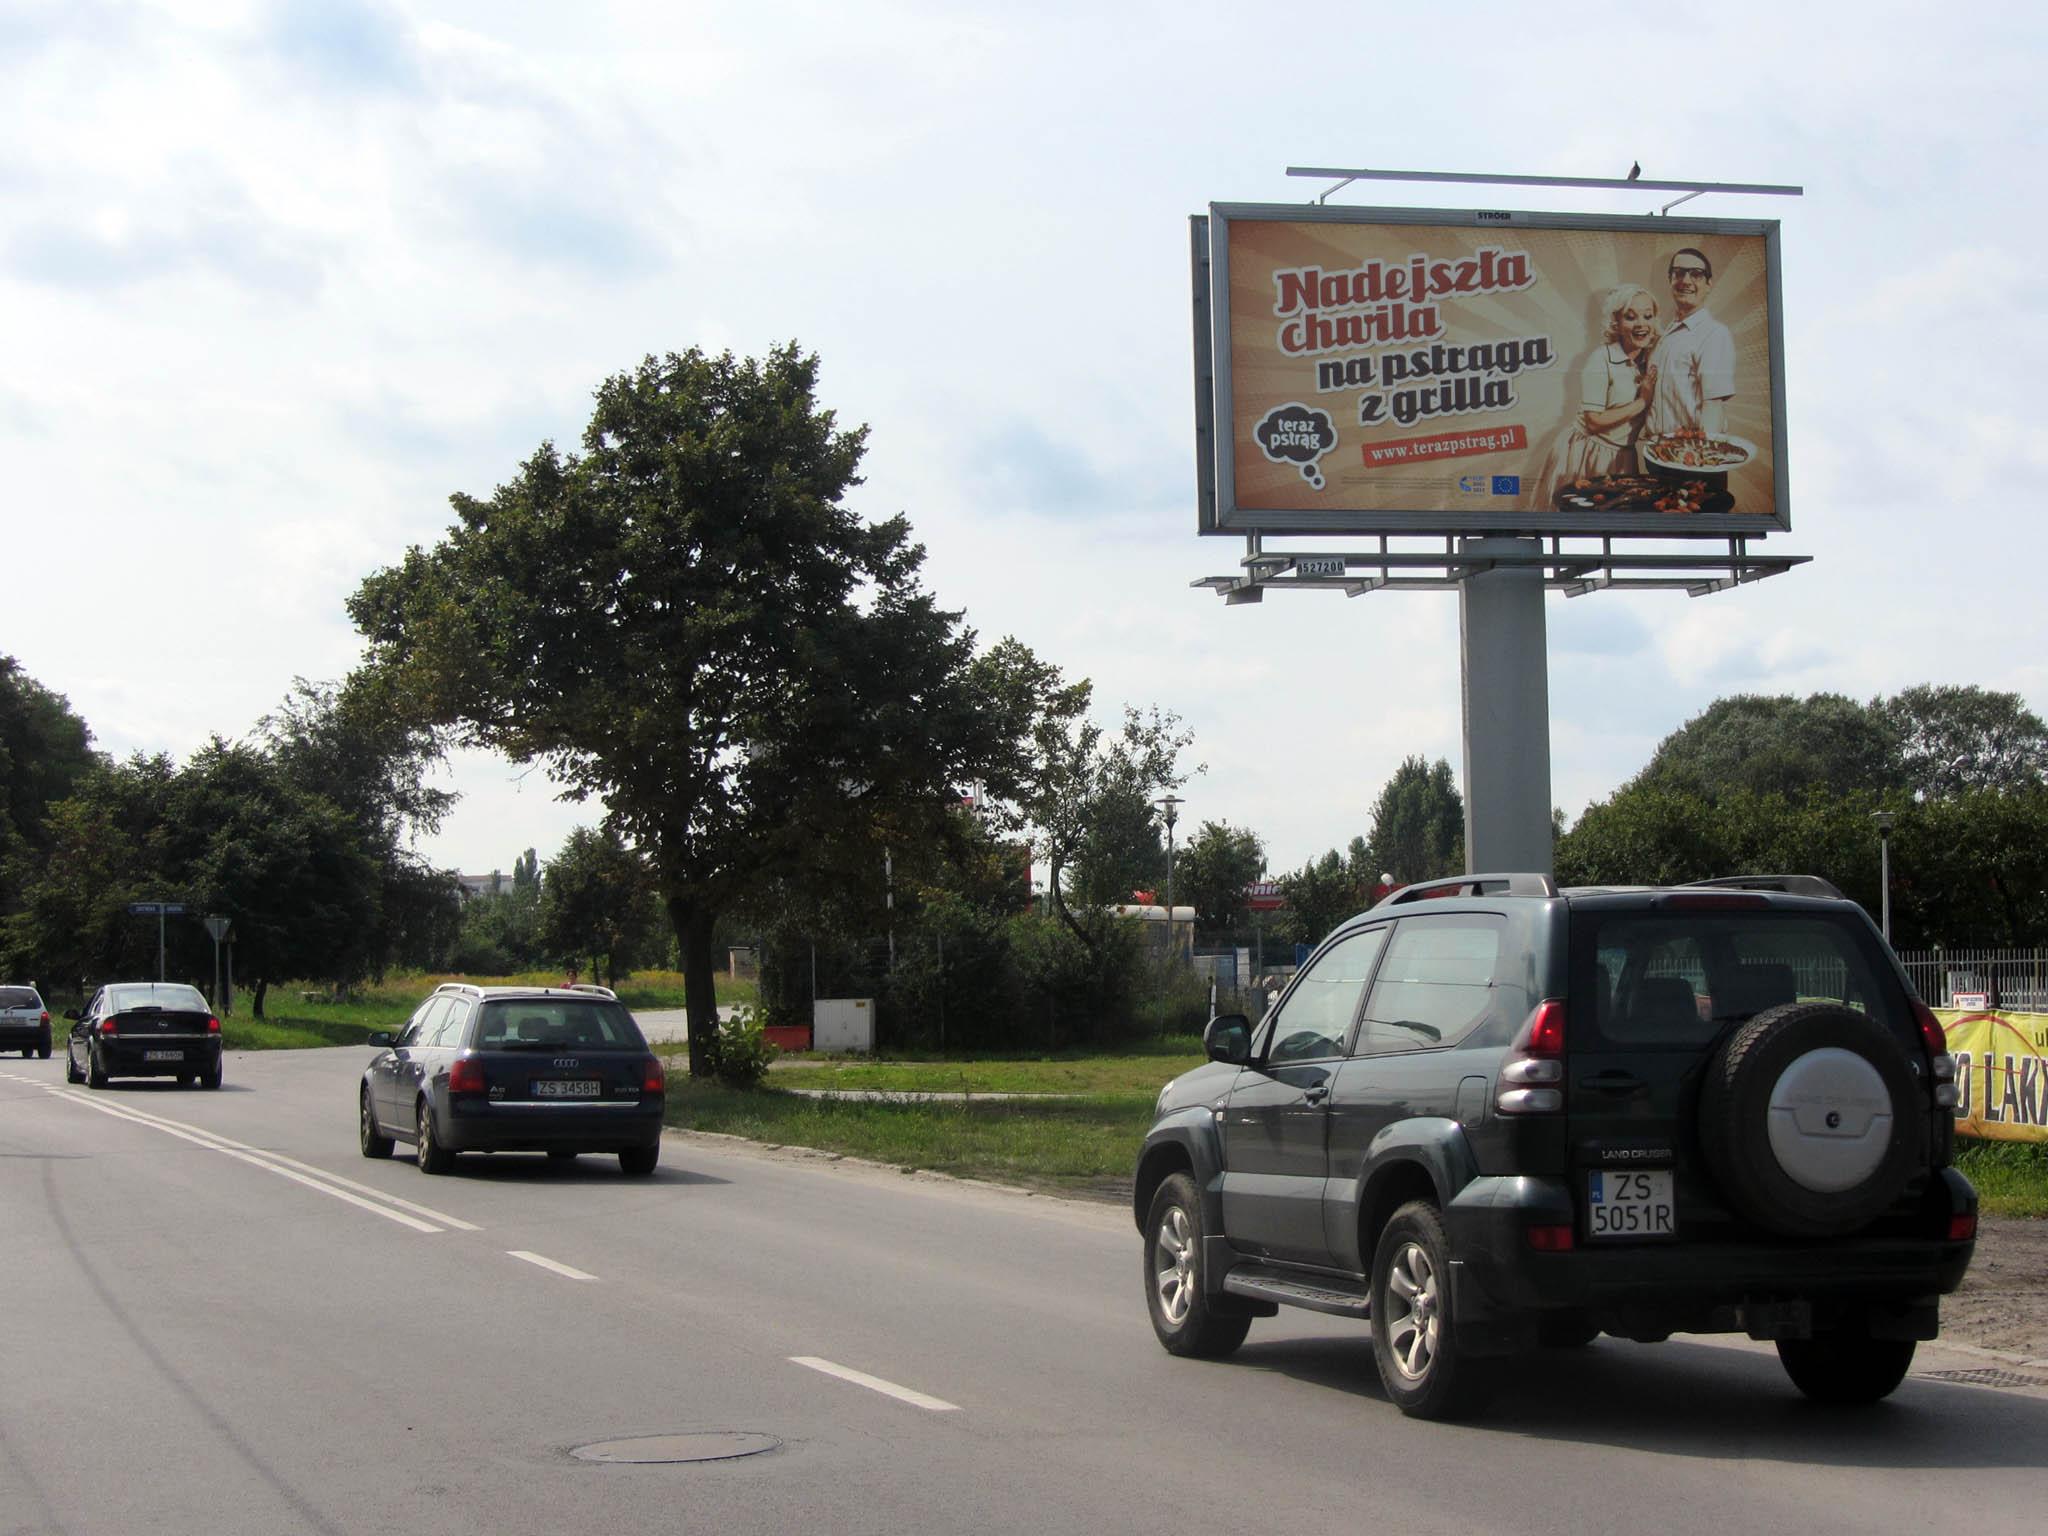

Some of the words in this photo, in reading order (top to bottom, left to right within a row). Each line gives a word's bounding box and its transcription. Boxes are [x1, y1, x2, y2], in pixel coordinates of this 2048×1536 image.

[1277, 249, 1532, 314] Nadejszła
[1281, 303, 1442, 353] chwila
[1319, 356, 1377, 390] na
[1361, 394, 1386, 422] z
[1392, 375, 1514, 424] grilla
[1278, 418, 1315, 432] teraz
[1271, 431, 1321, 450] pstrąg
[1371, 429, 1515, 461] www.terazpstrag.pl
[539, 1081, 557, 1095] ZS
[1602, 1150, 1630, 1159] LAND
[1614, 1174, 1651, 1200] ZS
[1595, 1204, 1673, 1232] 5051R
